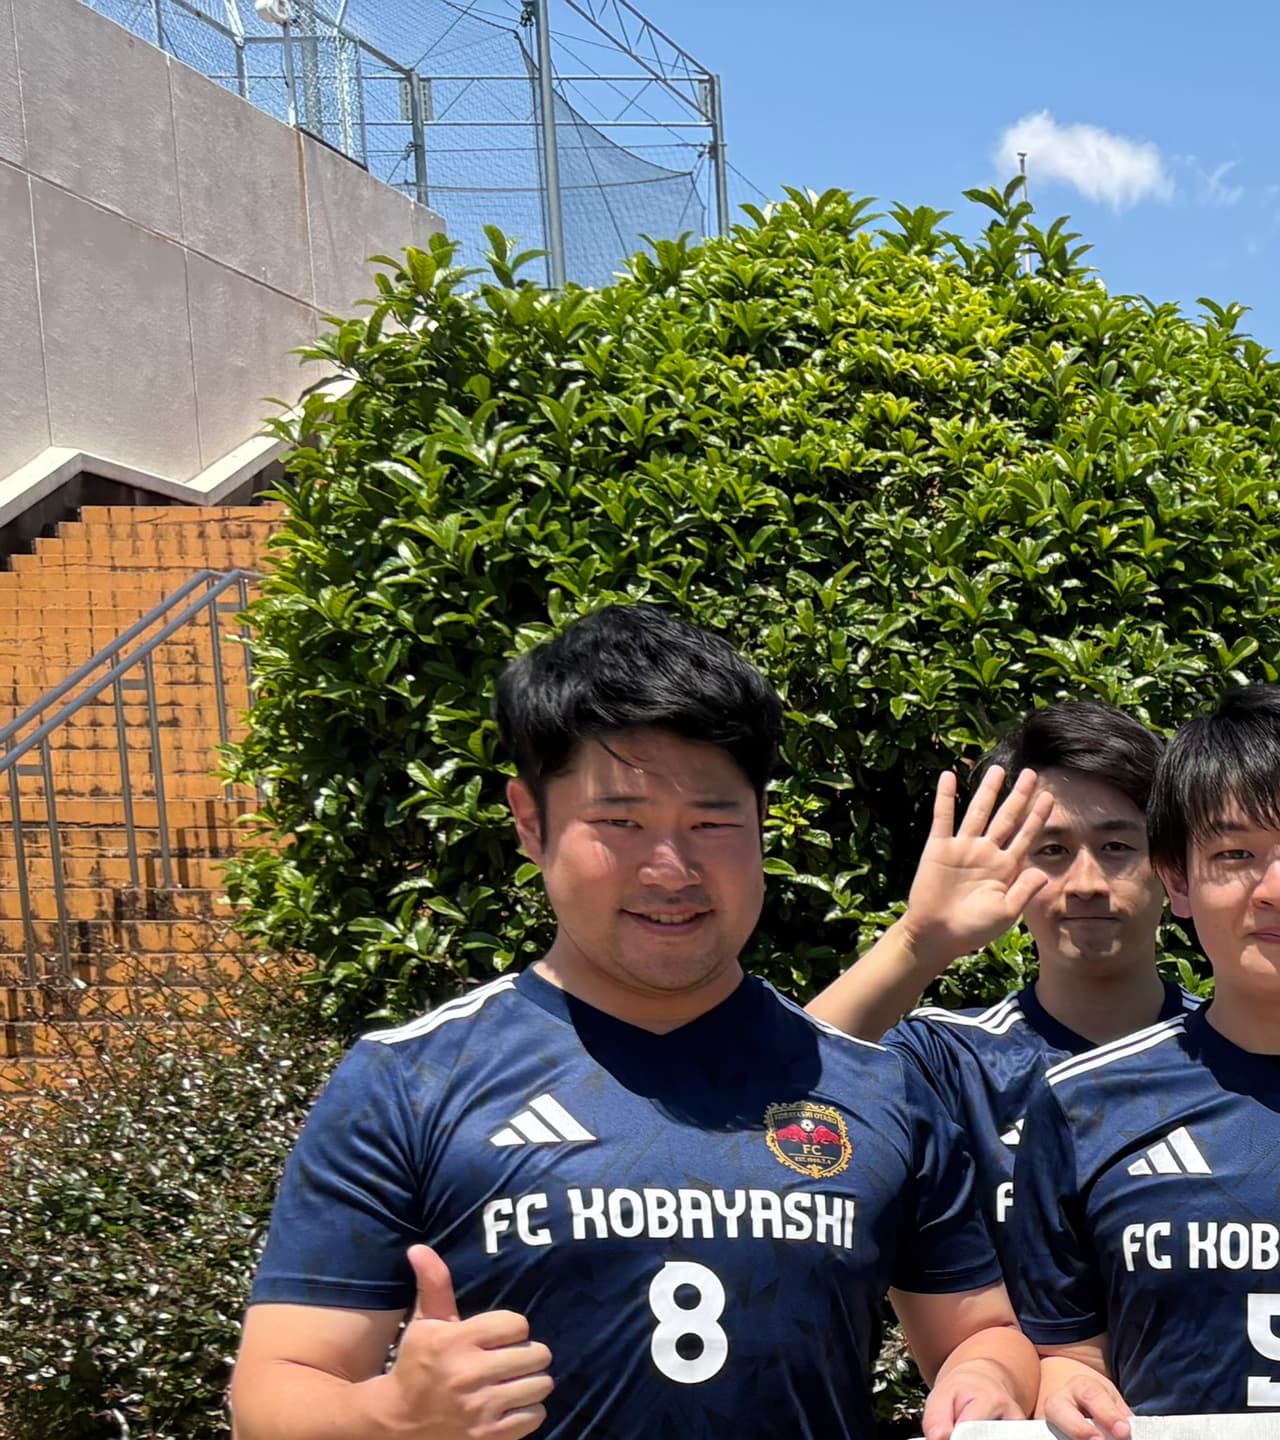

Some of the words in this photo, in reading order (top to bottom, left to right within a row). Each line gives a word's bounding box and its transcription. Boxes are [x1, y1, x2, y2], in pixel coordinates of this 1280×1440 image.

[803, 1144, 822, 1155] FC
[483, 1194, 553, 1254] FC
[567, 1188, 856, 1250] KOBAYASHI
[996, 1181, 1014, 1223] F
[1121, 1222, 1171, 1272] FC
[648, 1260, 728, 1384] 8
